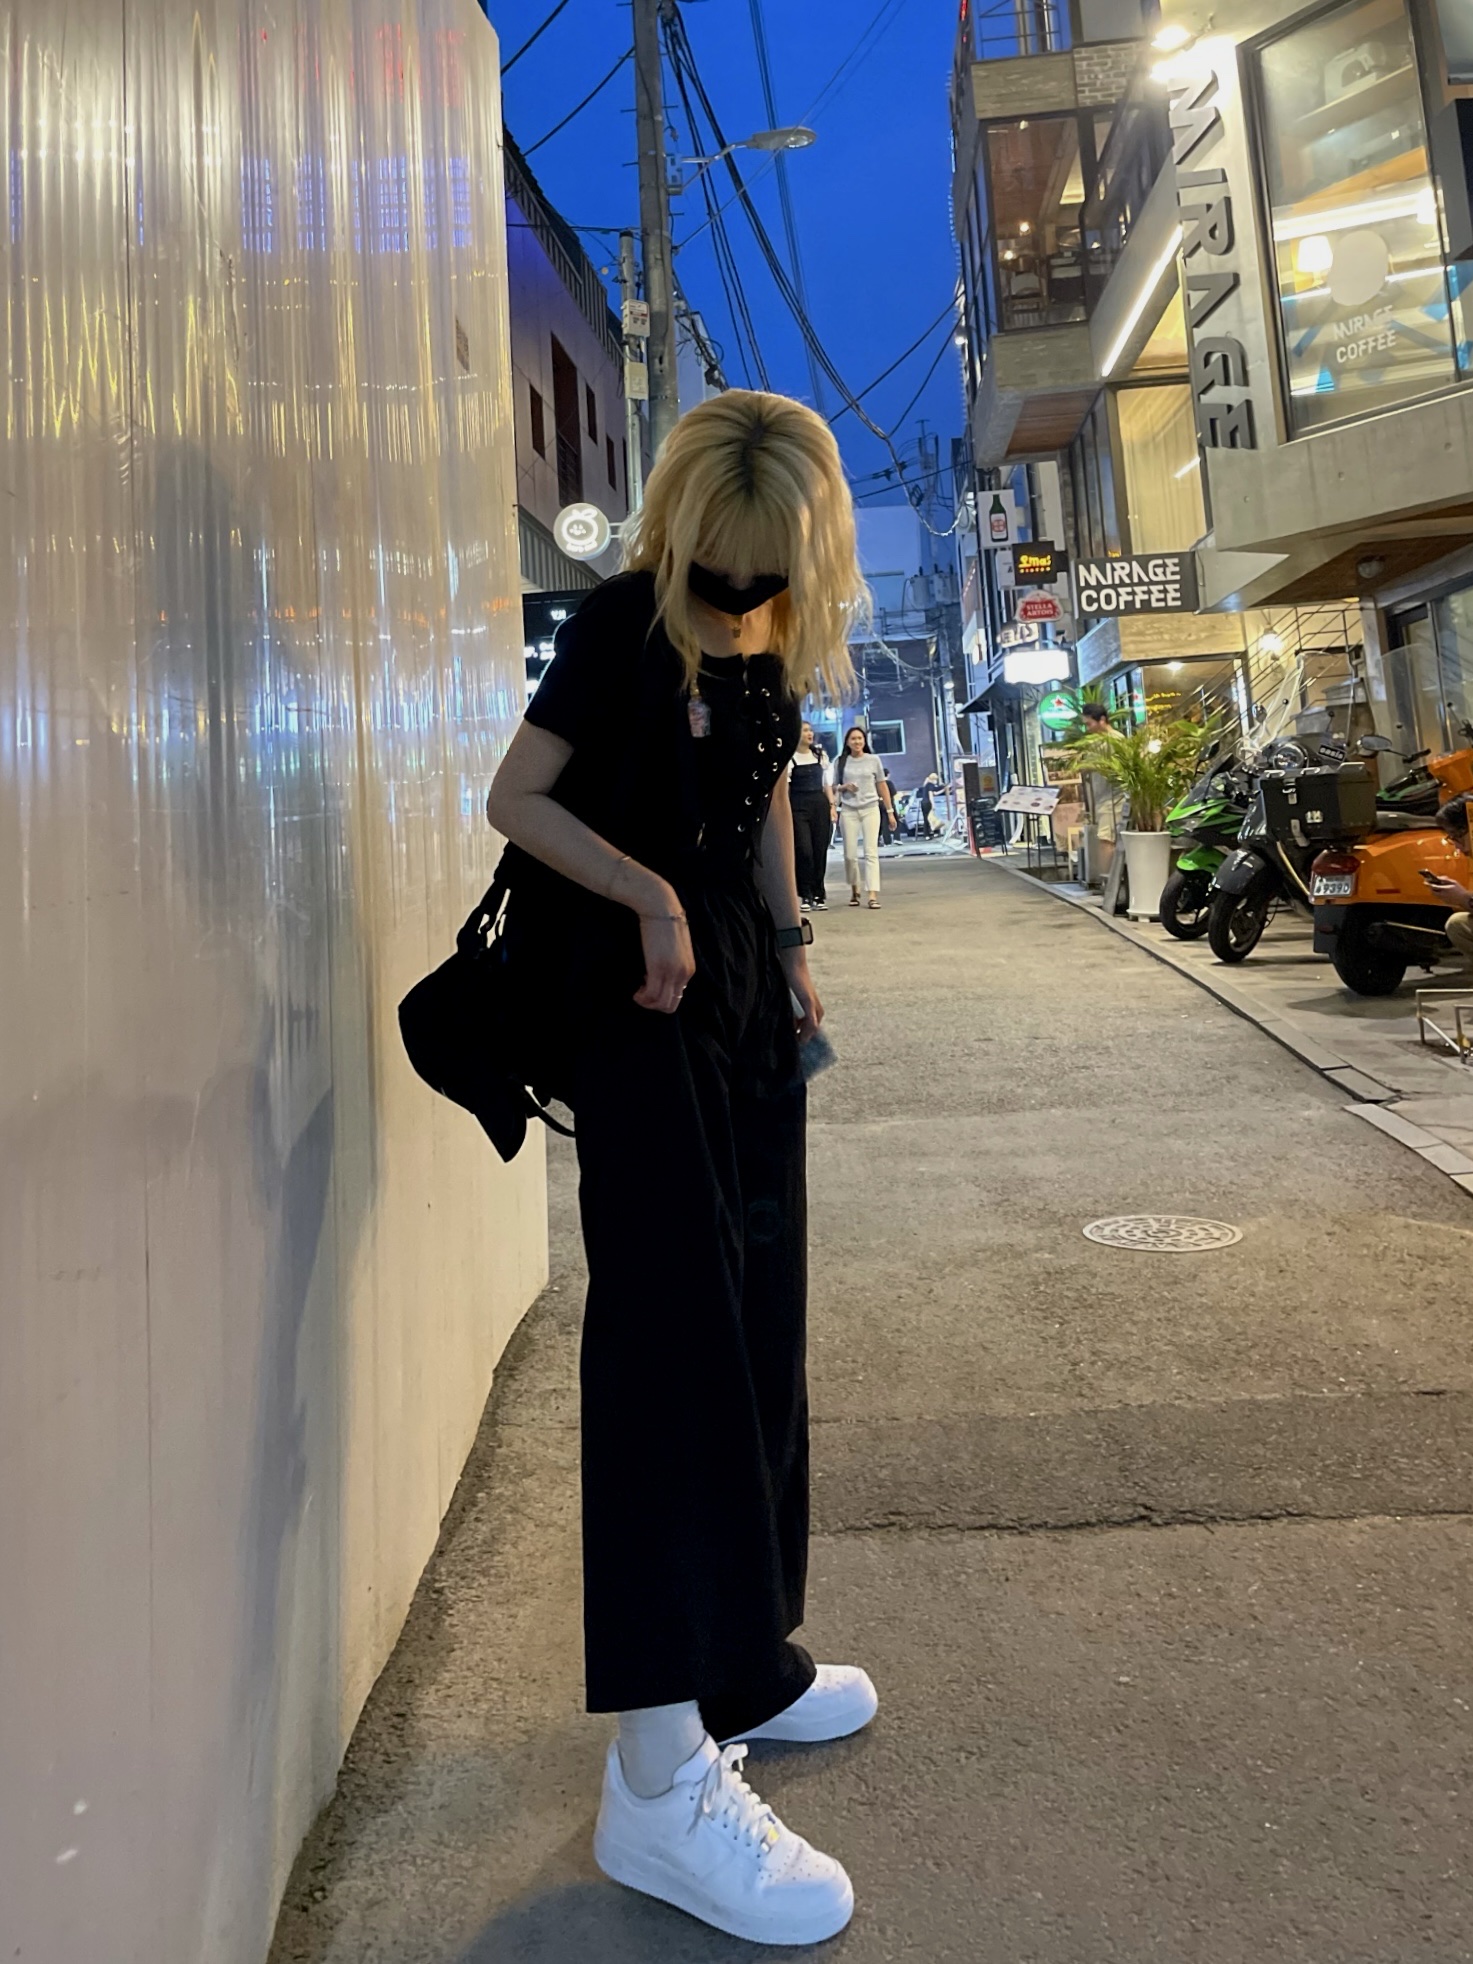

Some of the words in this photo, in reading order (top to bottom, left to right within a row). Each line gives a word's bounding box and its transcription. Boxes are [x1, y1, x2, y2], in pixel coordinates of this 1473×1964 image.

[1168, 69, 1256, 450] MIRAGE
[1333, 305, 1393, 340] MIRAGE
[1336, 330, 1396, 363] COFFEE
[1078, 558, 1181, 587] MIRAGE
[1026, 602, 1053, 610] STELLA
[1081, 584, 1182, 612] COFFEE
[1026, 609, 1054, 617] ARTOIS
